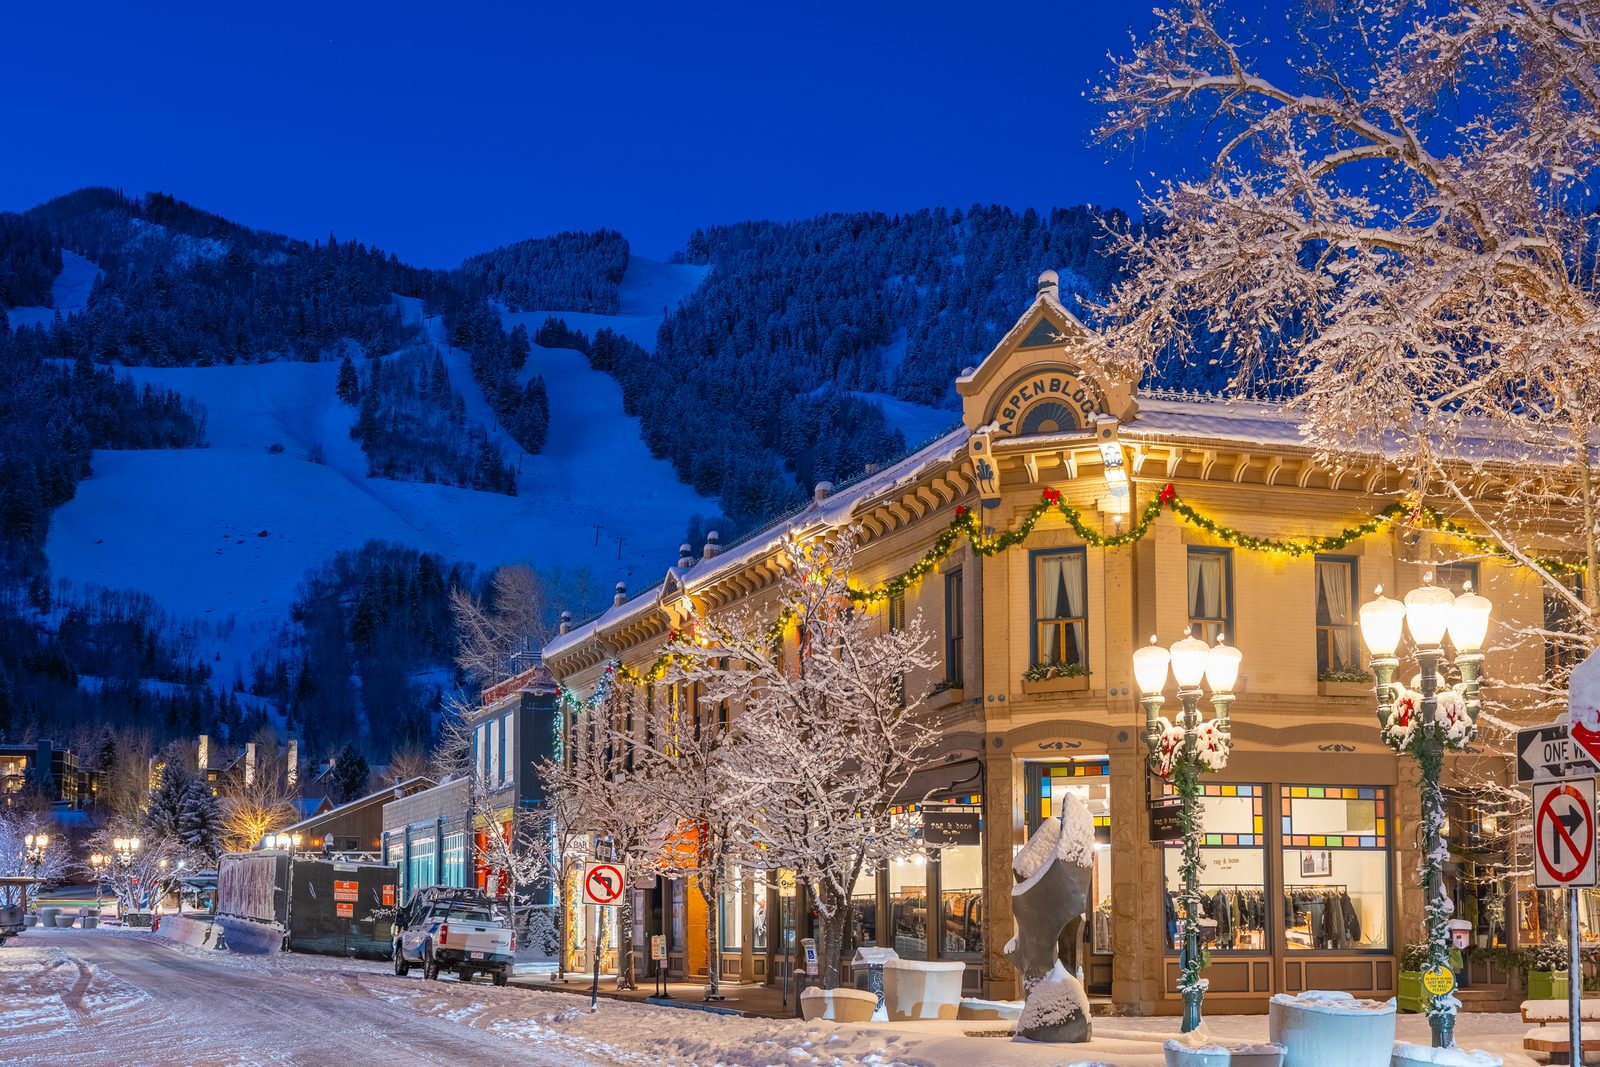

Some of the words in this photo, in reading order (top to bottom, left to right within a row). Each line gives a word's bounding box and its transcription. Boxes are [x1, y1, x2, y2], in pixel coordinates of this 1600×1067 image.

[999, 379, 1046, 434] ASPEN
[1543, 741, 1569, 763] ONE
[930, 822, 944, 831] rag
[955, 822, 973, 830] bone
[573, 841, 587, 849] BAR
